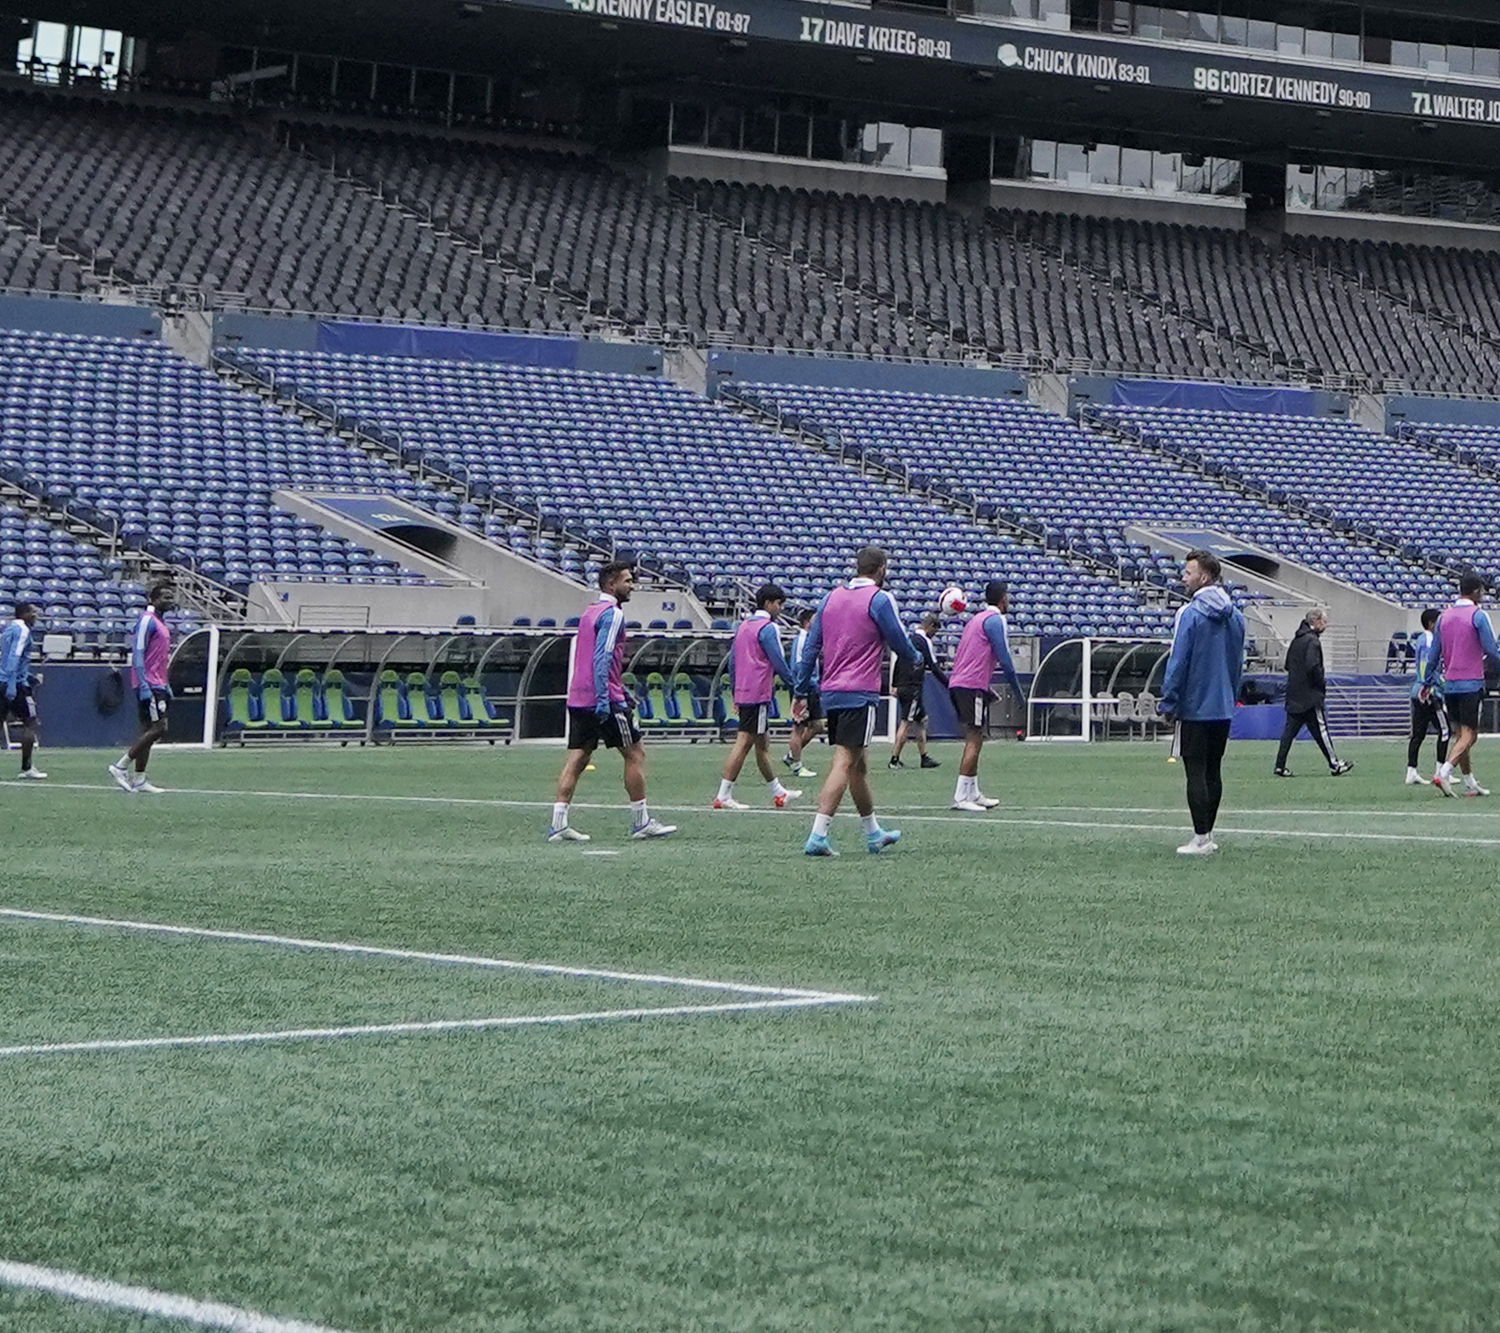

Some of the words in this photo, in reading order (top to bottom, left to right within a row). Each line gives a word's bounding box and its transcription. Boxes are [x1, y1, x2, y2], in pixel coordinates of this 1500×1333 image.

[715, 8, 751, 34] 81-87
[799, 16, 824, 43] 17
[824, 18, 865, 49] DAVE
[868, 24, 917, 56] KRIEG
[917, 36, 952, 60] 80-91
[1023, 46, 1074, 76] CHUCK
[1076, 53, 1118, 81] KNOX
[1118, 63, 1151, 85] 83-91
[1193, 67, 1221, 92] 96
[1220, 70, 1273, 99] CORTEZ
[1275, 76, 1339, 106] KENNEDY
[1338, 88, 1371, 109] 90-00
[1411, 91, 1433, 115] 71
[1432, 92, 1485, 122] WALTER
